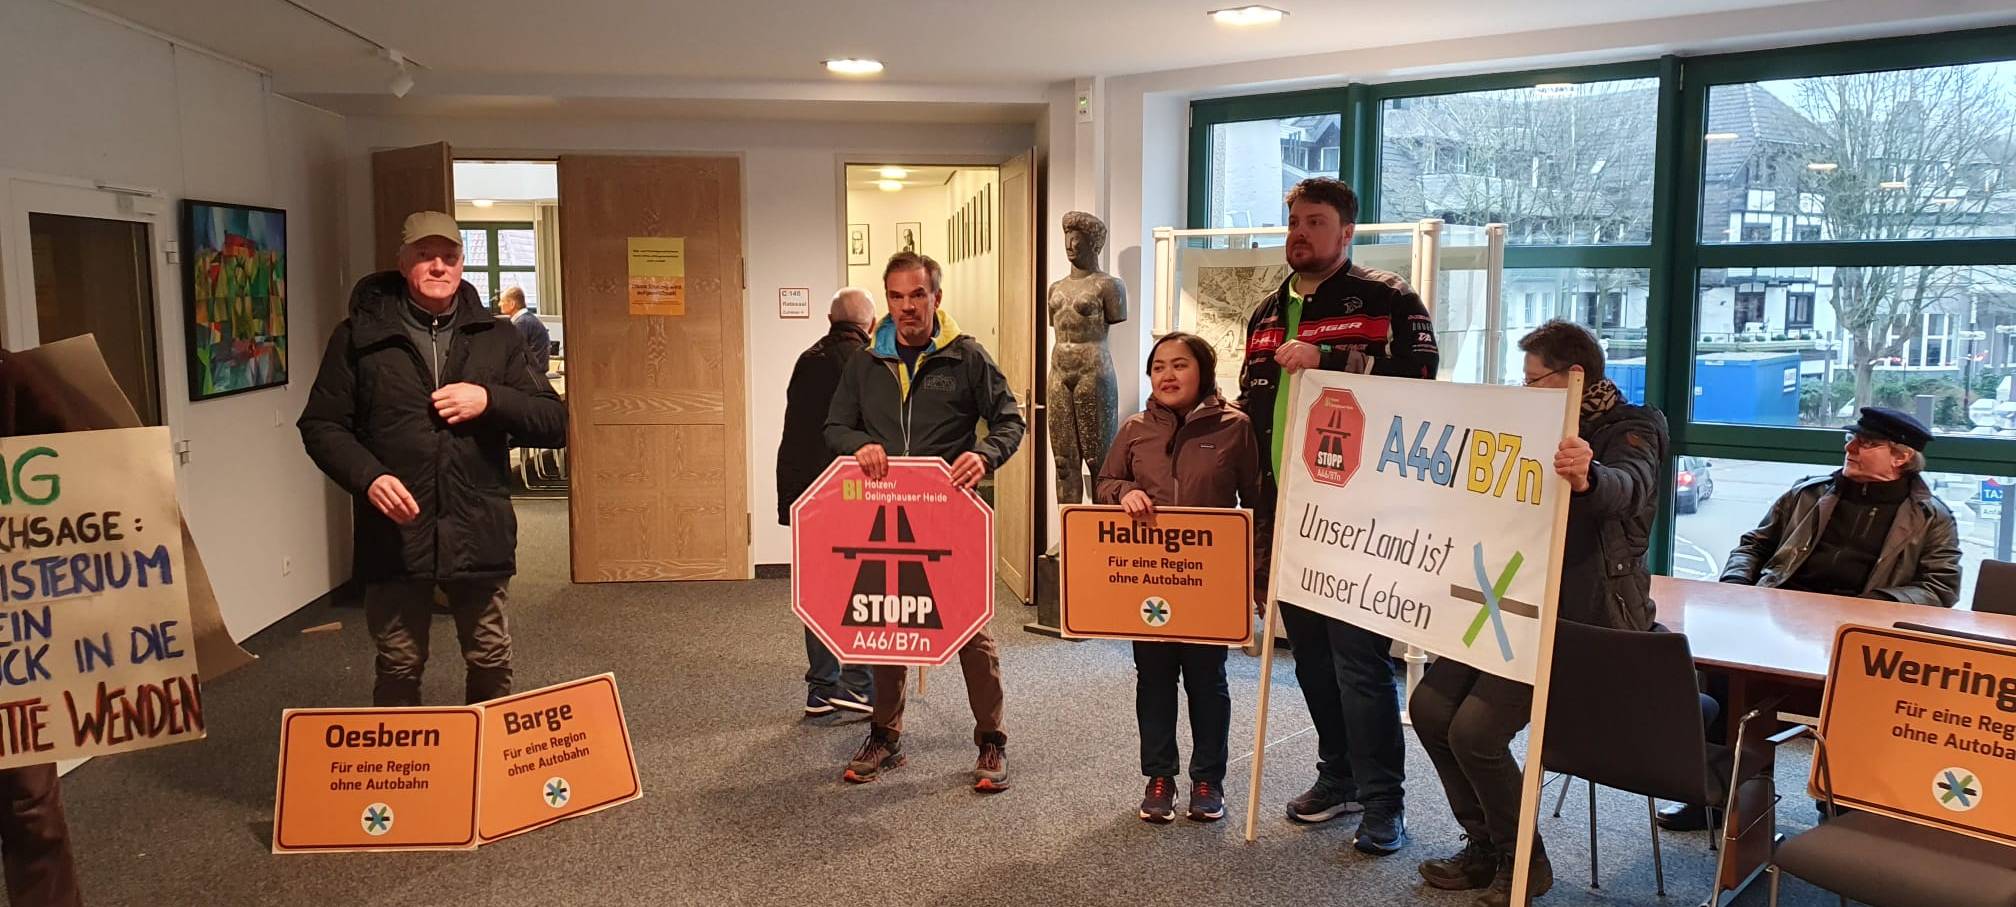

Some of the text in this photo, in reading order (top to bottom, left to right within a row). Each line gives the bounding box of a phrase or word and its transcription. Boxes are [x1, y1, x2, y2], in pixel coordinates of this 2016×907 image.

[1317, 451, 1343, 468] STOPP
[1376, 415, 1544, 506] A46/B7n
[843, 479, 862, 500] BI
[923, 493, 948, 503] Heide
[1098, 520, 1213, 553] Halingen
[1300, 502, 1454, 576] Unser Land ist
[1108, 556, 1203, 572] Für eine Region
[1109, 572, 1203, 586] ohne Autobahn
[852, 593, 933, 624] STOPP
[1301, 567, 1432, 630] unser Leben
[74, 632, 114, 674] IN
[131, 620, 184, 665] DIE
[852, 630, 931, 652] A46/B7n
[64, 673, 205, 748] WENDEN
[503, 704, 573, 735] Barge
[1895, 700, 1927, 718] Für
[1932, 708, 1972, 728] eine
[325, 722, 440, 748] Oesbern
[503, 731, 586, 761] Für eine Region
[1892, 723, 1938, 745] ohne
[331, 760, 430, 776] Für eine Region
[508, 747, 590, 777] ohne Autobahn
[330, 777, 429, 791] ohne Autobahn
